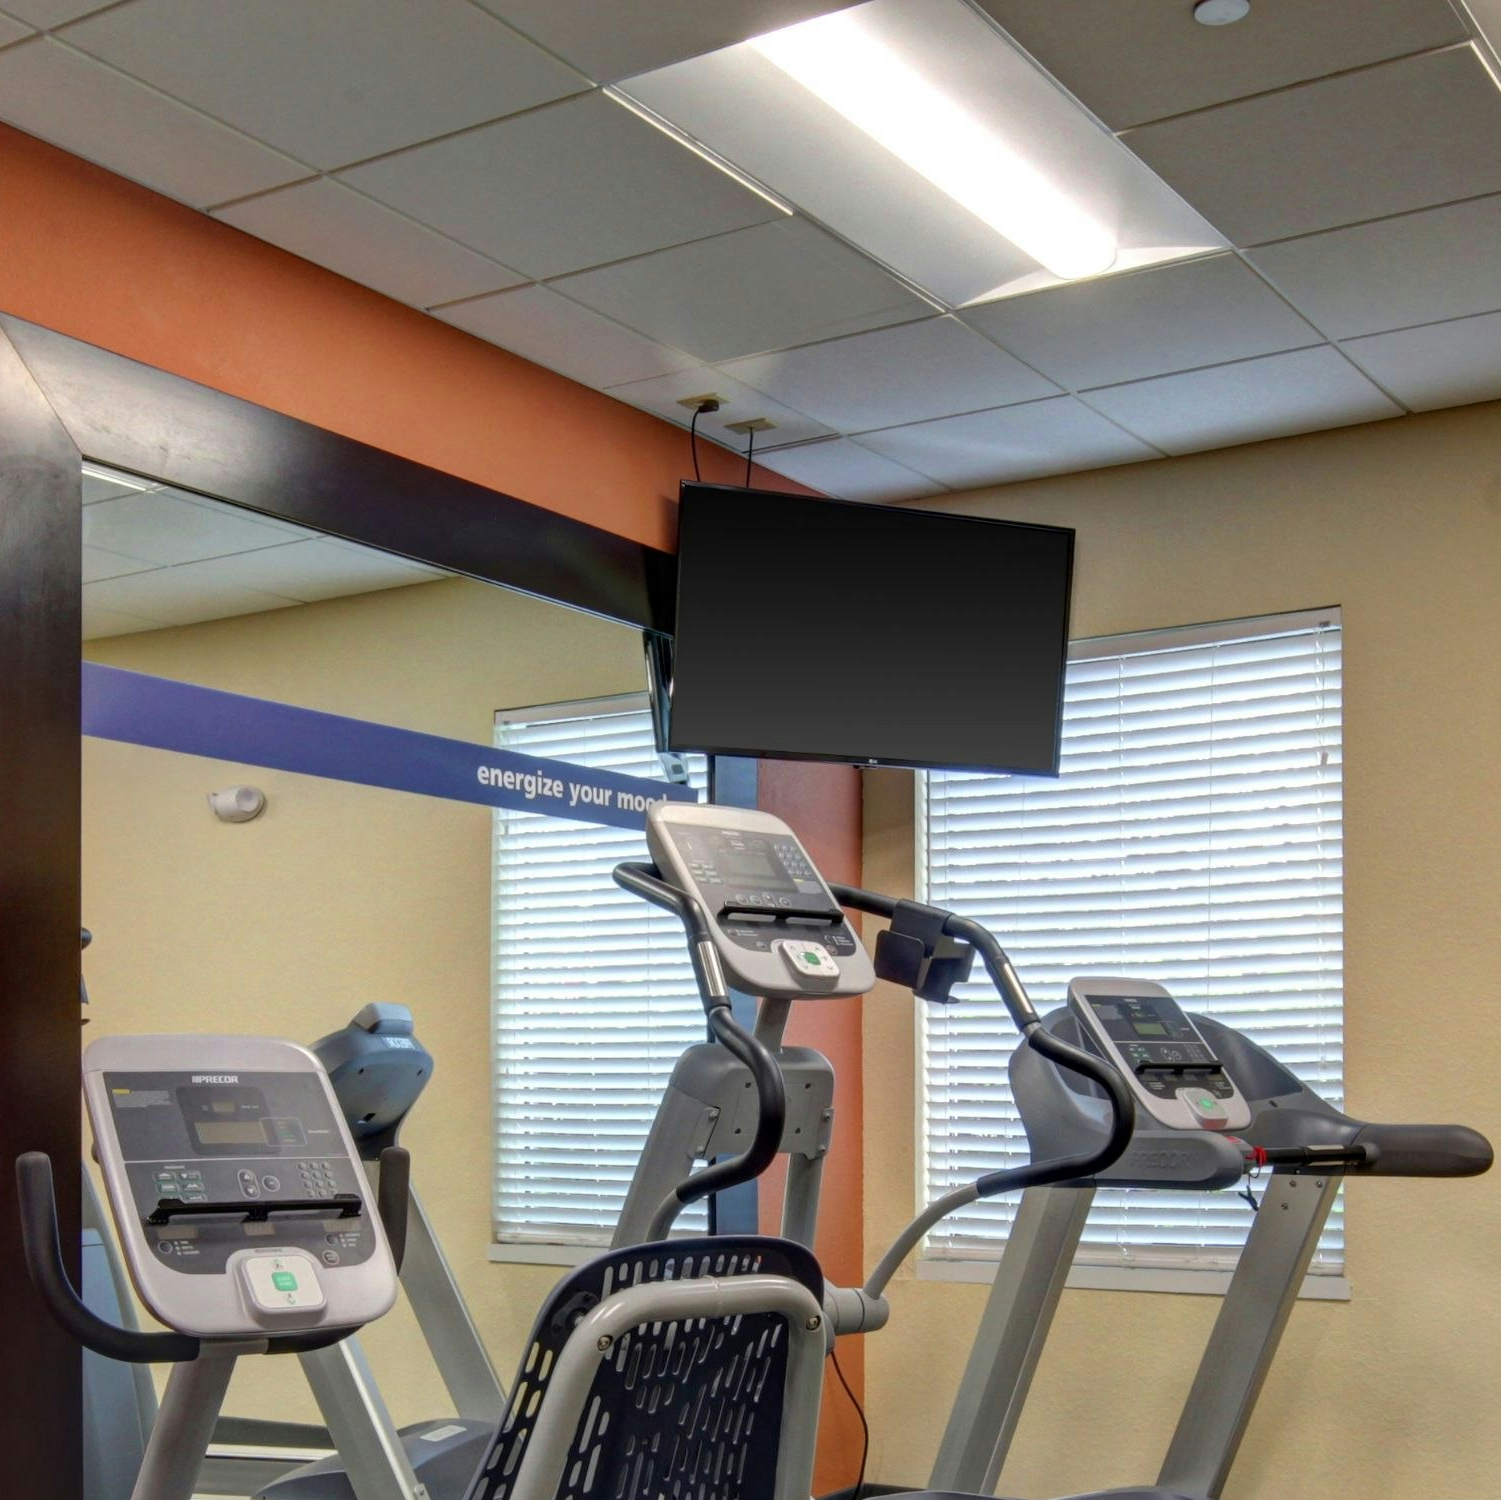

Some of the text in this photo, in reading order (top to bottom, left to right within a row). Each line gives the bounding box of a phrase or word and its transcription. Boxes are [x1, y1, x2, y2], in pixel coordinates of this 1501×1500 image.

[477, 765, 564, 799] energize
[569, 782, 612, 806] your
[198, 1075, 239, 1084] PRECOR
